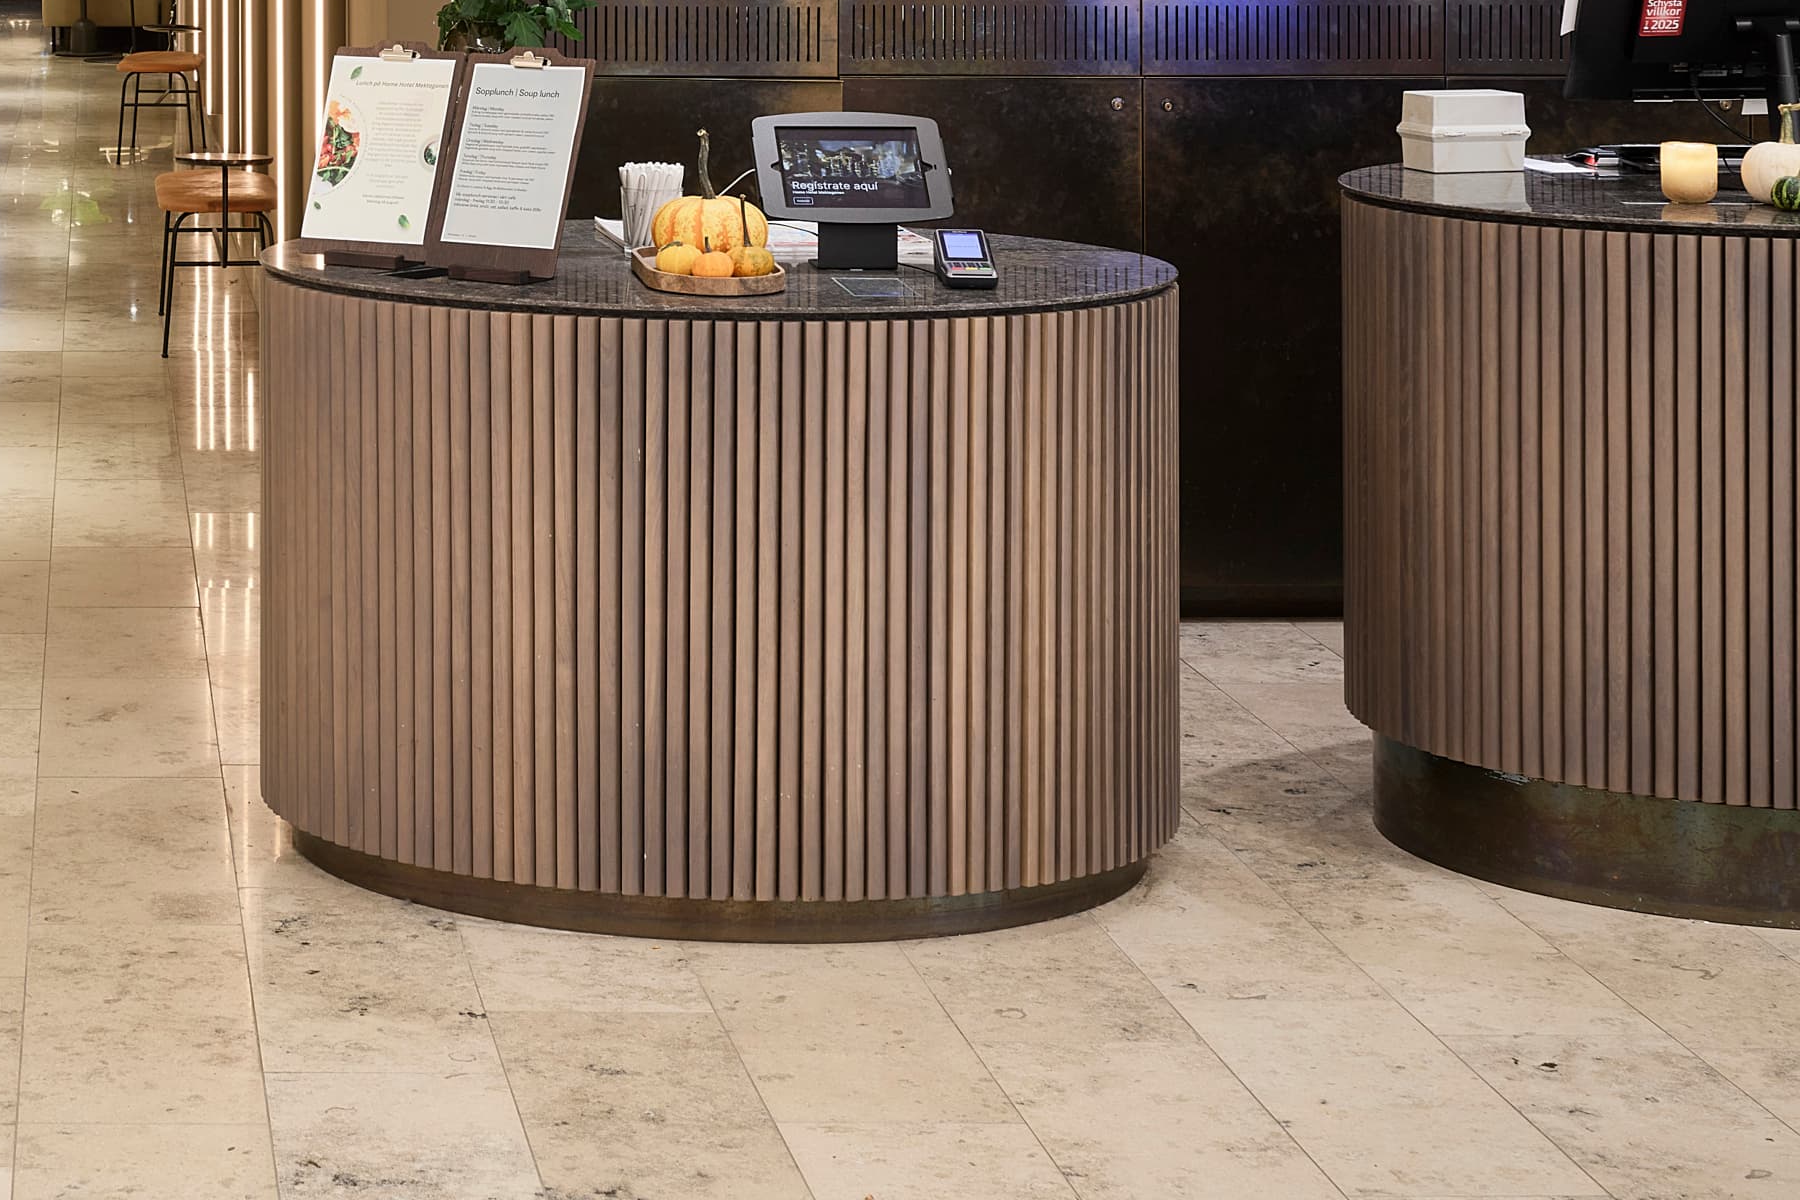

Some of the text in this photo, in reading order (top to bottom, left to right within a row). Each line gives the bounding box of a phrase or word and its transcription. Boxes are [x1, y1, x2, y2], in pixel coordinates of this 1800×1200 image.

[1648, 0, 1682, 7] Schysta
[1646, 6, 1682, 16] villkor
[1650, 20, 1679, 30] 2025
[475, 87, 514, 96] Sopplunch
[519, 89, 538, 99] Soup
[539, 90, 560, 98] lunch
[854, 181, 878, 192] aquí
